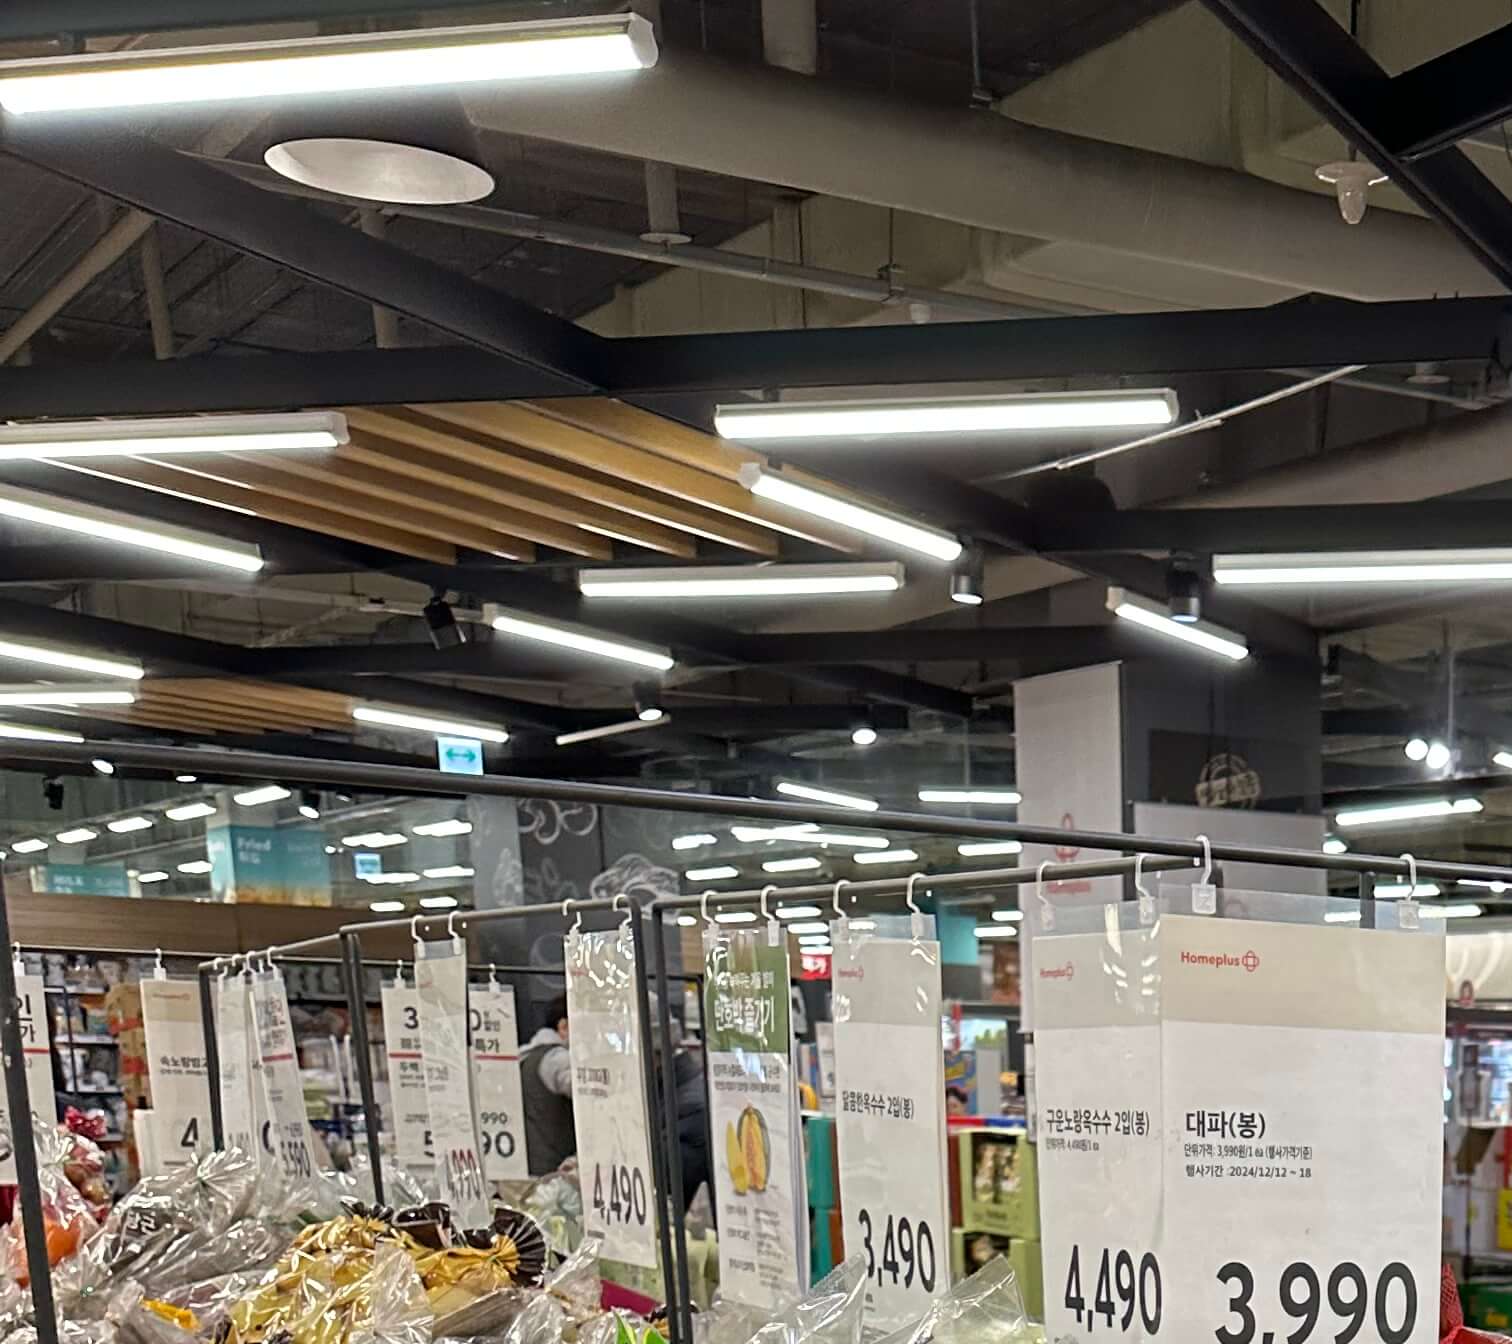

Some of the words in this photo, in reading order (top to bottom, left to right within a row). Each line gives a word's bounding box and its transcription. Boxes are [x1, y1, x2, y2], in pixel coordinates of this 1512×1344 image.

[1180, 951, 1241, 970] Homeplus
[1046, 1109, 1112, 1135] 구운노랑옥수수
[1114, 1110, 1151, 1137] 2입(봉)
[1185, 1110, 1266, 1140] 대파(봉)
[1186, 1164, 1223, 1178] 행사기간
[1299, 1167, 1312, 1178] 18
[594, 1162, 647, 1226] 4,490
[858, 1208, 936, 1294] 3,490
[1064, 1244, 1163, 1336] 4,490
